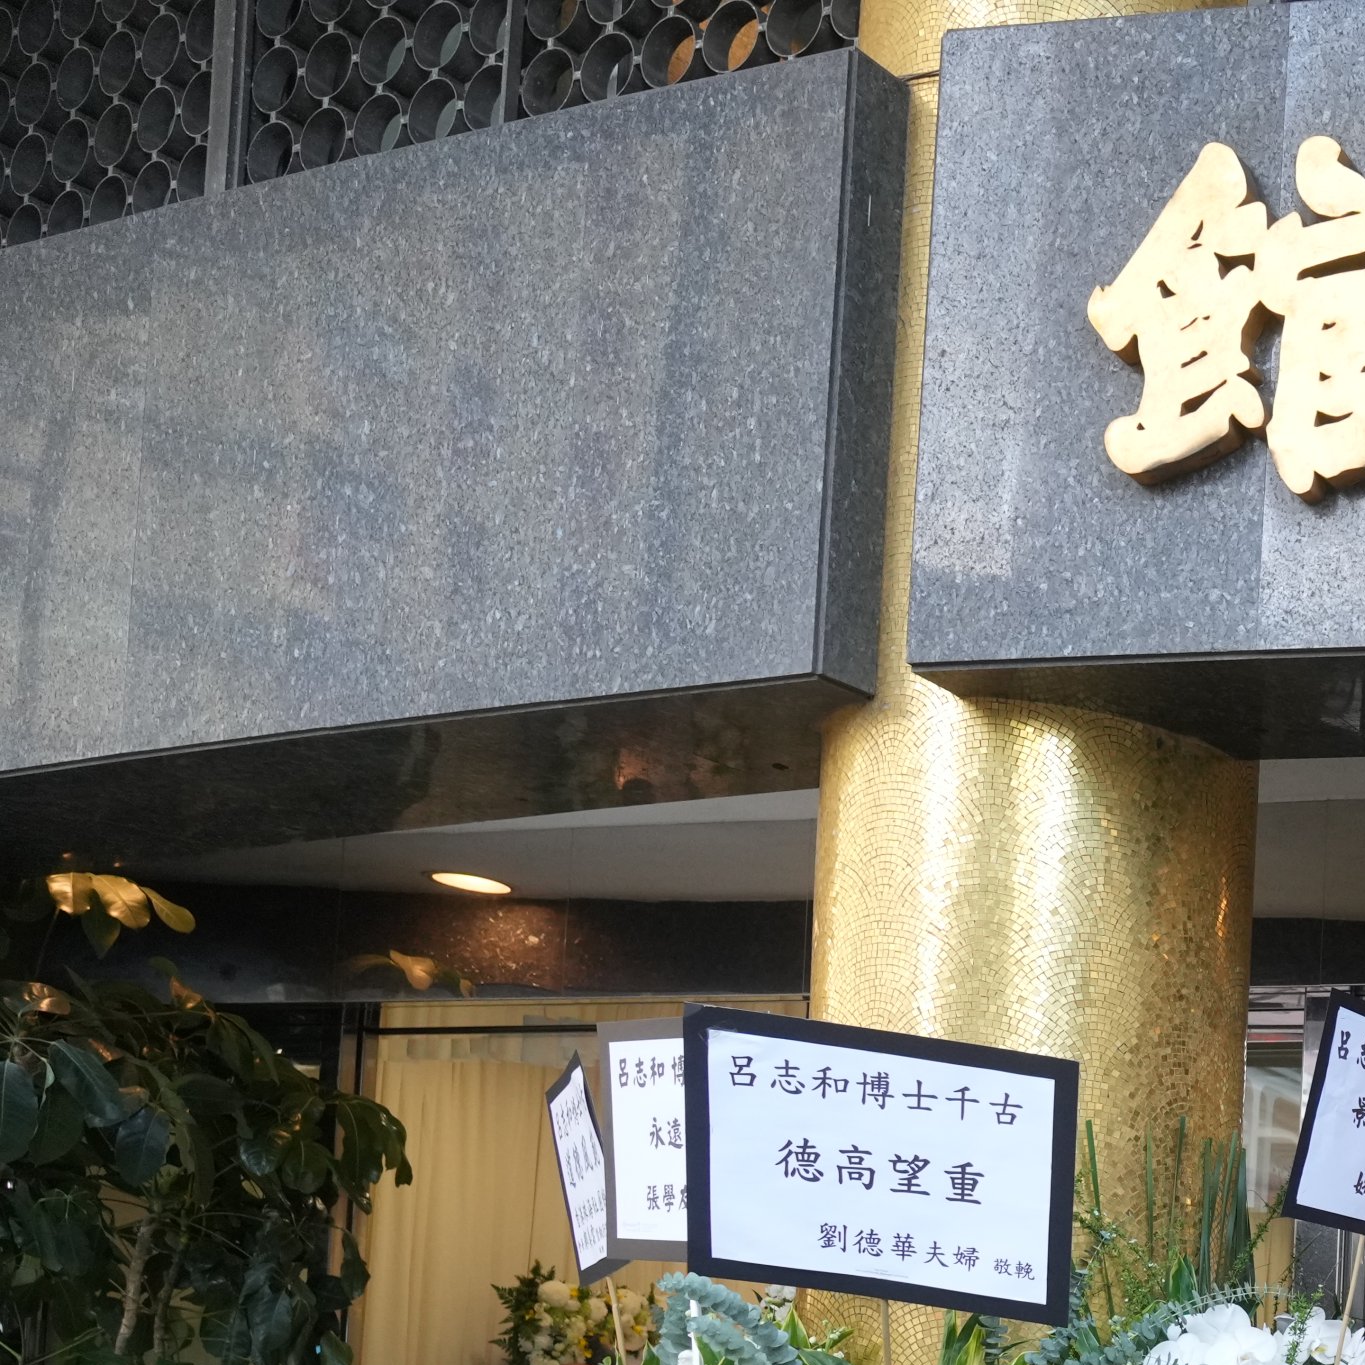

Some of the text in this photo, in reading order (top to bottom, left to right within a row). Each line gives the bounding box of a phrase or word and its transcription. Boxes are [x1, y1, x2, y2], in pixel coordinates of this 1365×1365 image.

[729, 1055, 1024, 1126] 呂志和博士千古
[775, 1137, 985, 1205] 德高望重
[817, 1222, 1036, 1281] 劉德華夫婦 敬輓
